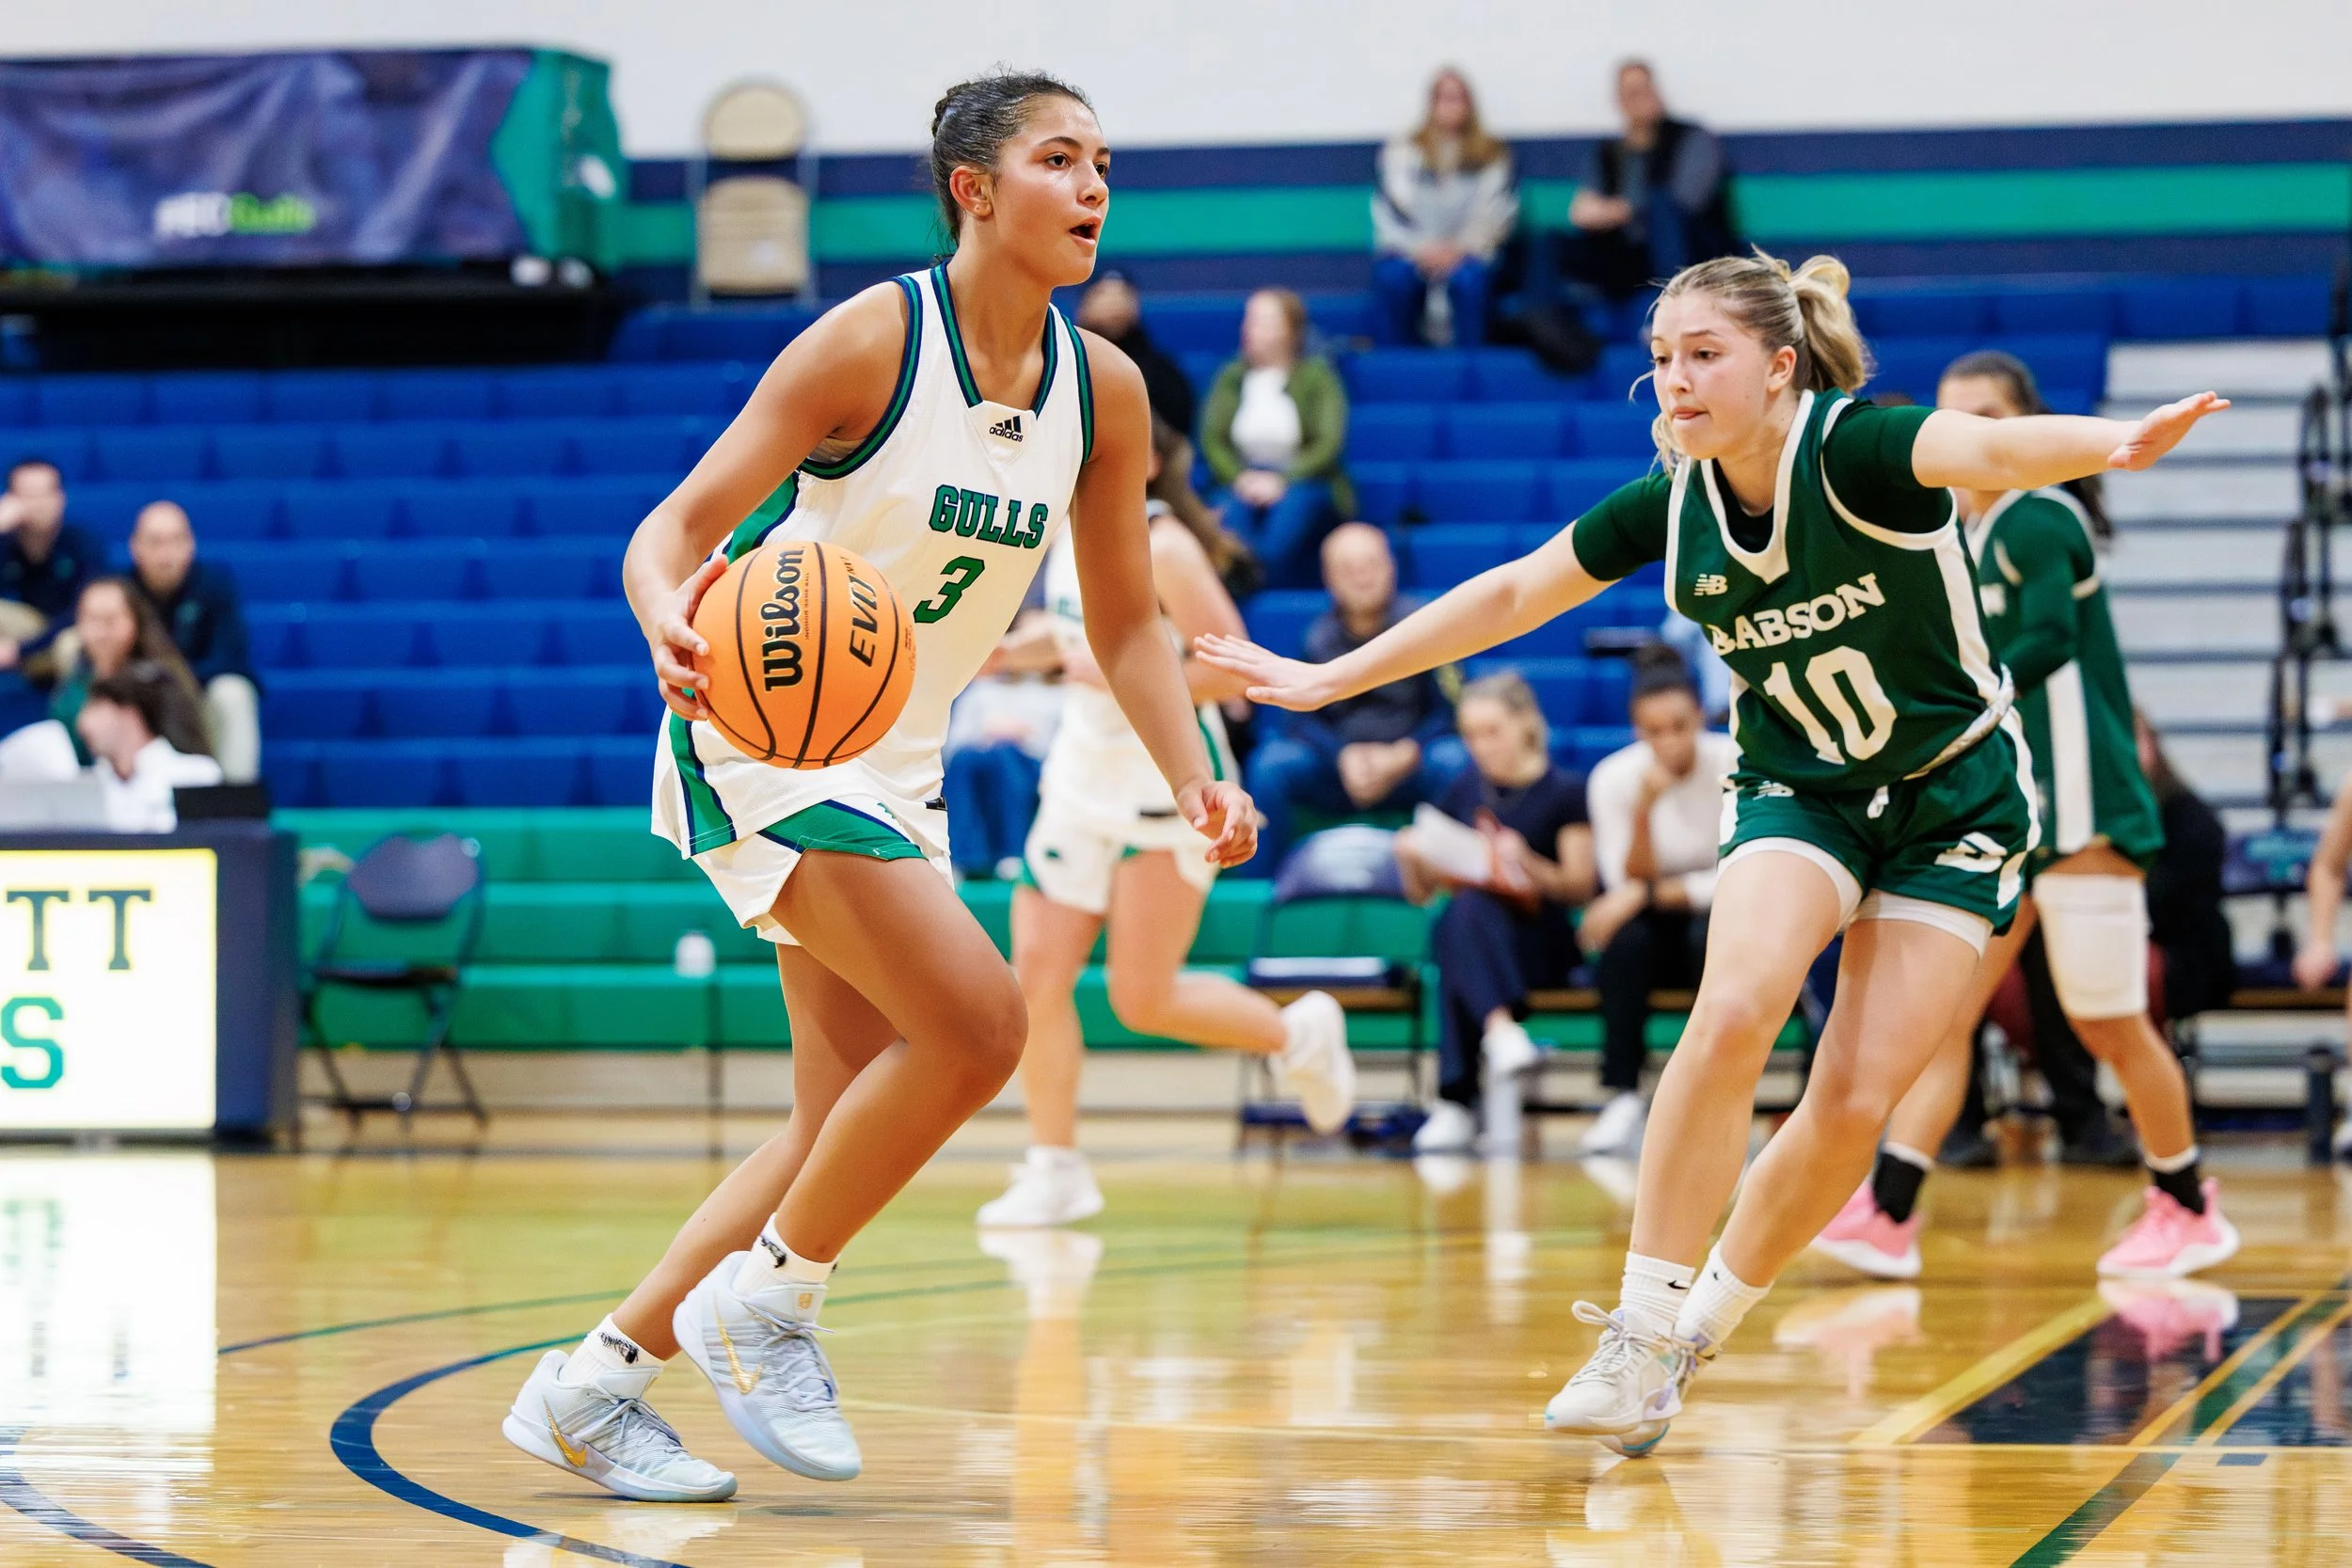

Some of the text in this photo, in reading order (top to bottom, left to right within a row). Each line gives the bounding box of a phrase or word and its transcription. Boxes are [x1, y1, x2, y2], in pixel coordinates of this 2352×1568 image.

[989, 426, 1024, 442] adidas
[929, 484, 1048, 548] GULLS
[760, 549, 804, 692] Wilson
[849, 575, 878, 668] EVO
[913, 556, 985, 624] 3
[1762, 645, 1898, 765] 10
[7, 890, 151, 971] TT
[0, 997, 64, 1088] S
